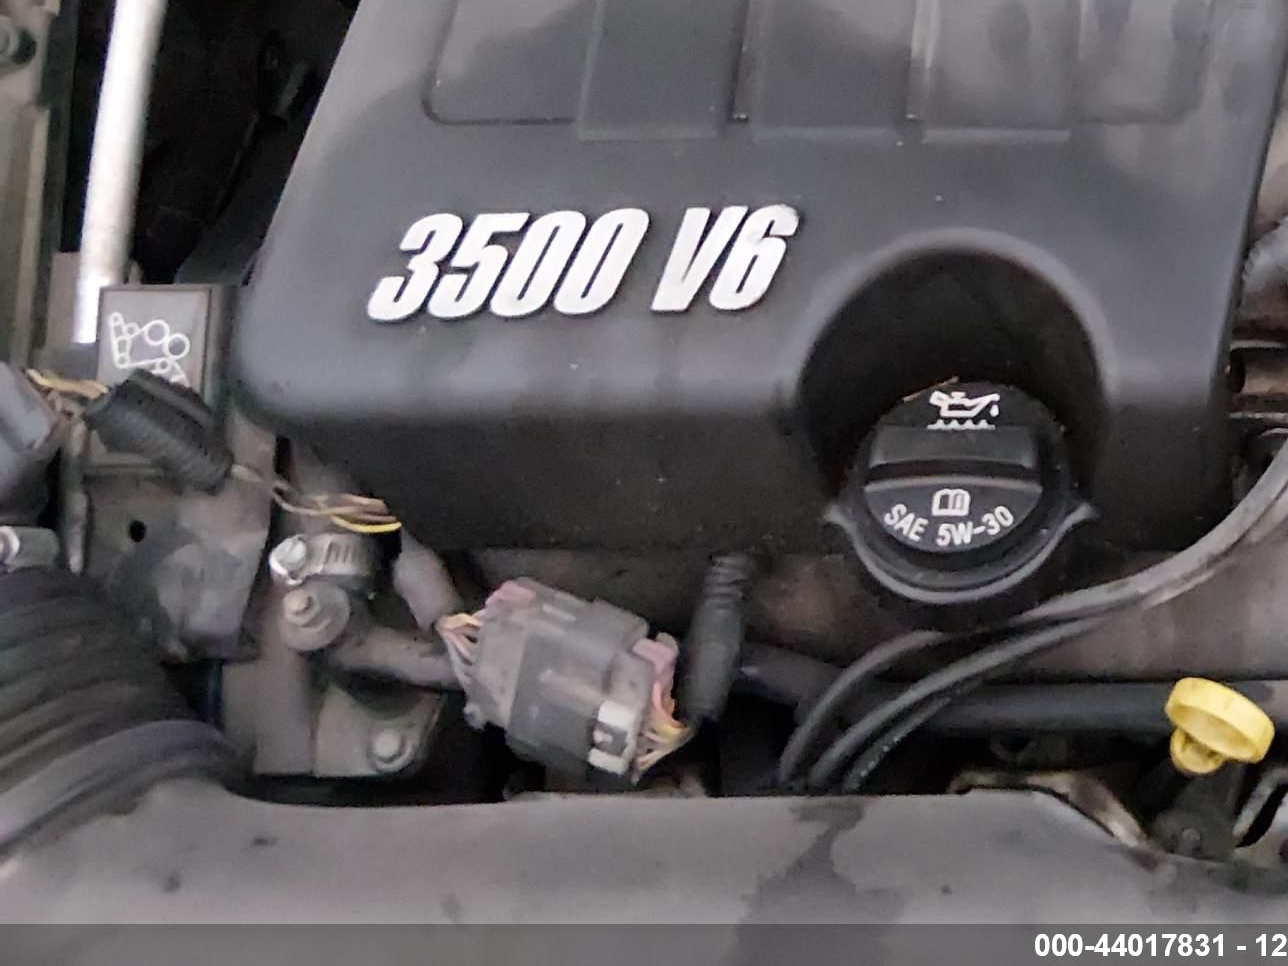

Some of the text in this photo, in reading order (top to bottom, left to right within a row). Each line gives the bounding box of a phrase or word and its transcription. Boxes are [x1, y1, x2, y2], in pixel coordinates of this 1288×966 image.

[366, 203, 799, 321] 3500 V6
[883, 503, 1015, 548] SAE 5W-30
